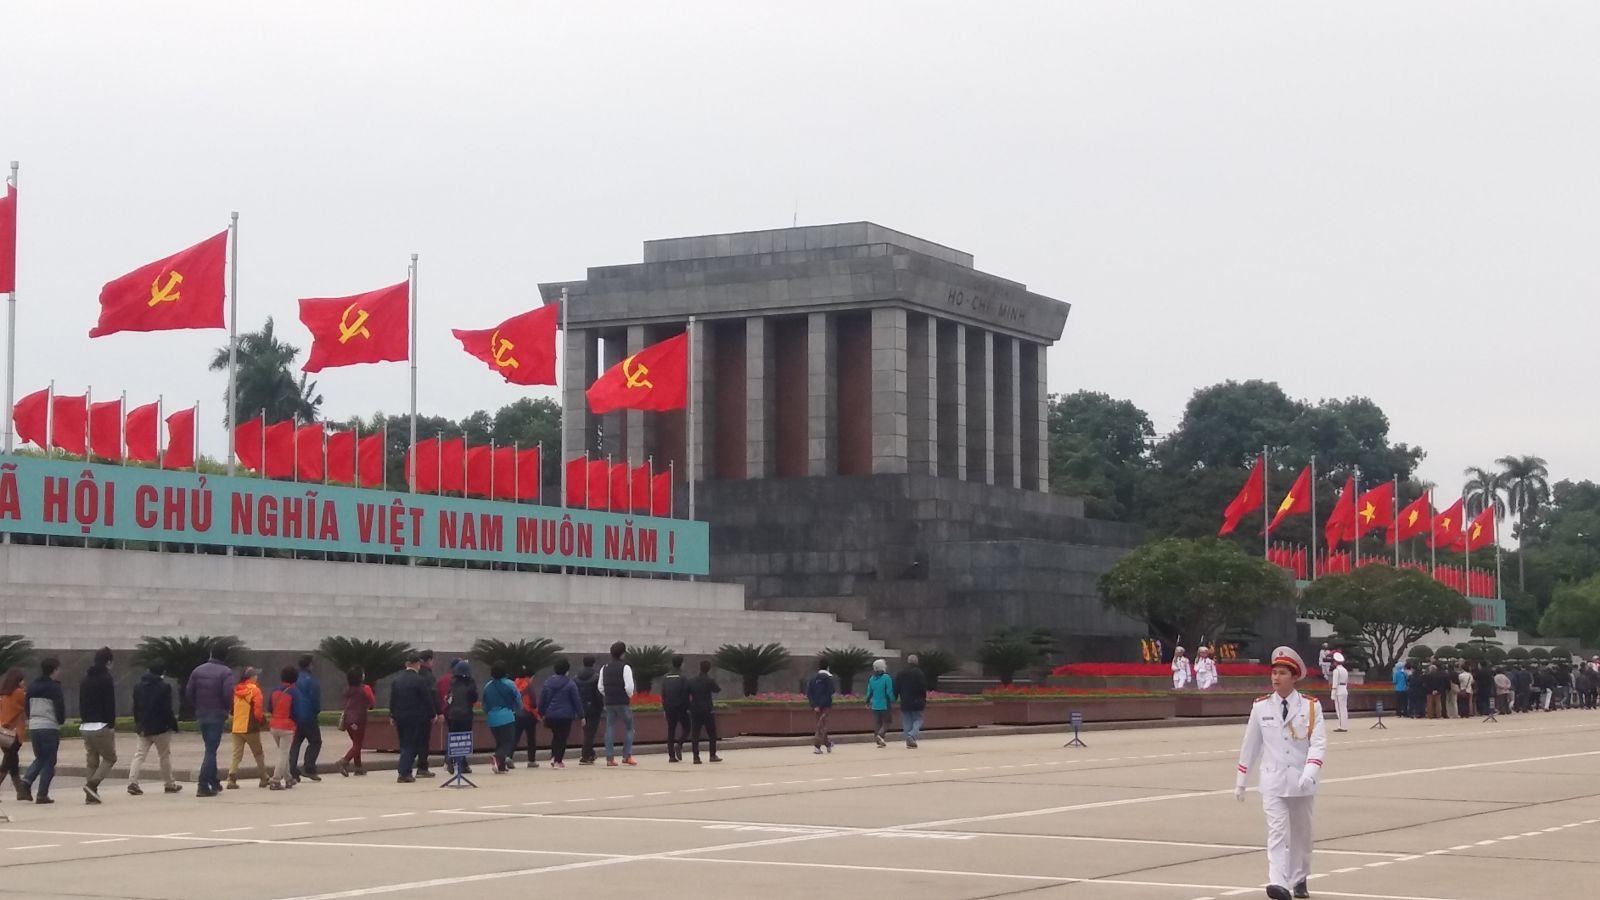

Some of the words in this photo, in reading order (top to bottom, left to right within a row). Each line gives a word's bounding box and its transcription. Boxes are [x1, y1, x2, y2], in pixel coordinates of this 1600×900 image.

[43, 469, 115, 534] HỘI
[135, 476, 213, 533] CHỦ
[231, 490, 340, 541] NGHĨA
[357, 497, 425, 553] VIỆT
[439, 510, 504, 552] NAM
[516, 513, 593, 558] MUÔN
[604, 519, 658, 563] NĂM
